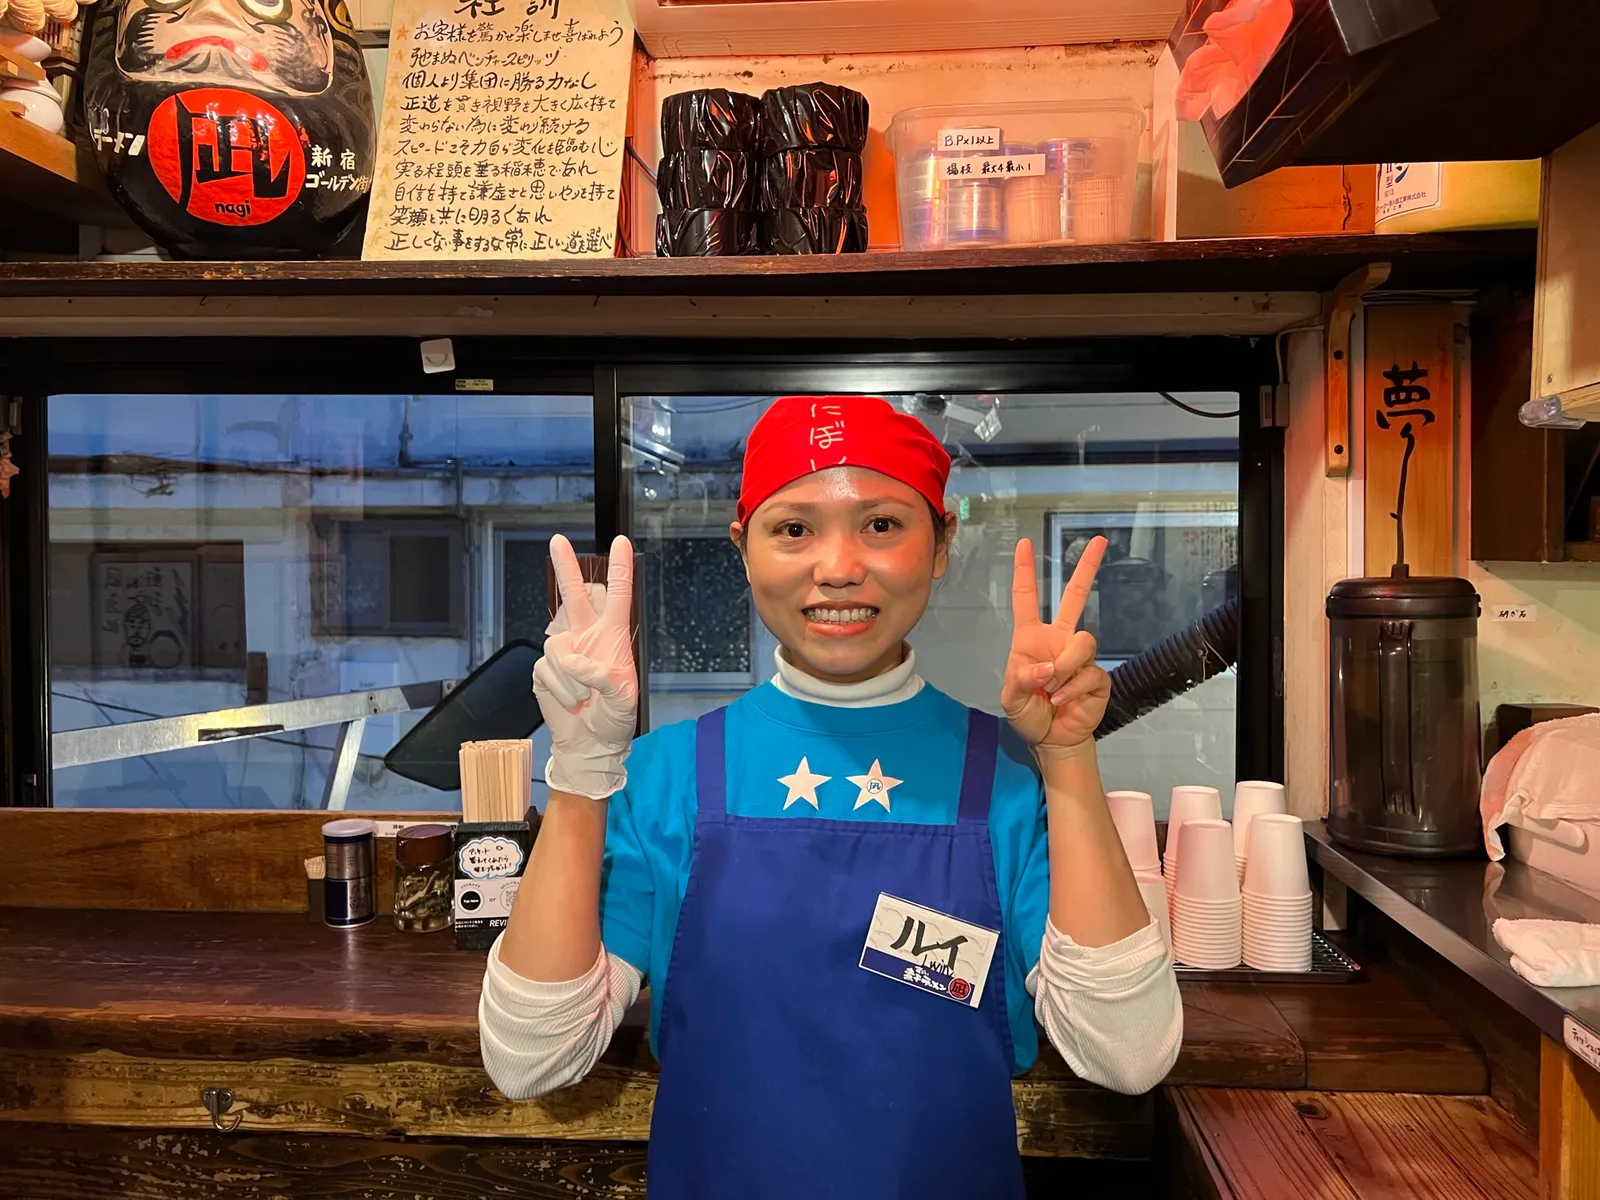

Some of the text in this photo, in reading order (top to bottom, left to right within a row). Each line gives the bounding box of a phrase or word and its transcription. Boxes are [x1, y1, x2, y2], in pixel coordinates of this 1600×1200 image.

[402, 69, 597, 91] 個人より集団に勝る力なし
[400, 93, 617, 114] 正道を貫き視野を大きく広く持て
[399, 114, 590, 135] 変わらない為に変わり続ける
[311, 144, 356, 170] 新宿
[305, 170, 371, 194] ゴールデン街
[214, 200, 251, 218] nagi
[389, 204, 552, 227] 笑顔と共に明るくあれ
[890, 915, 968, 971] ルイ
